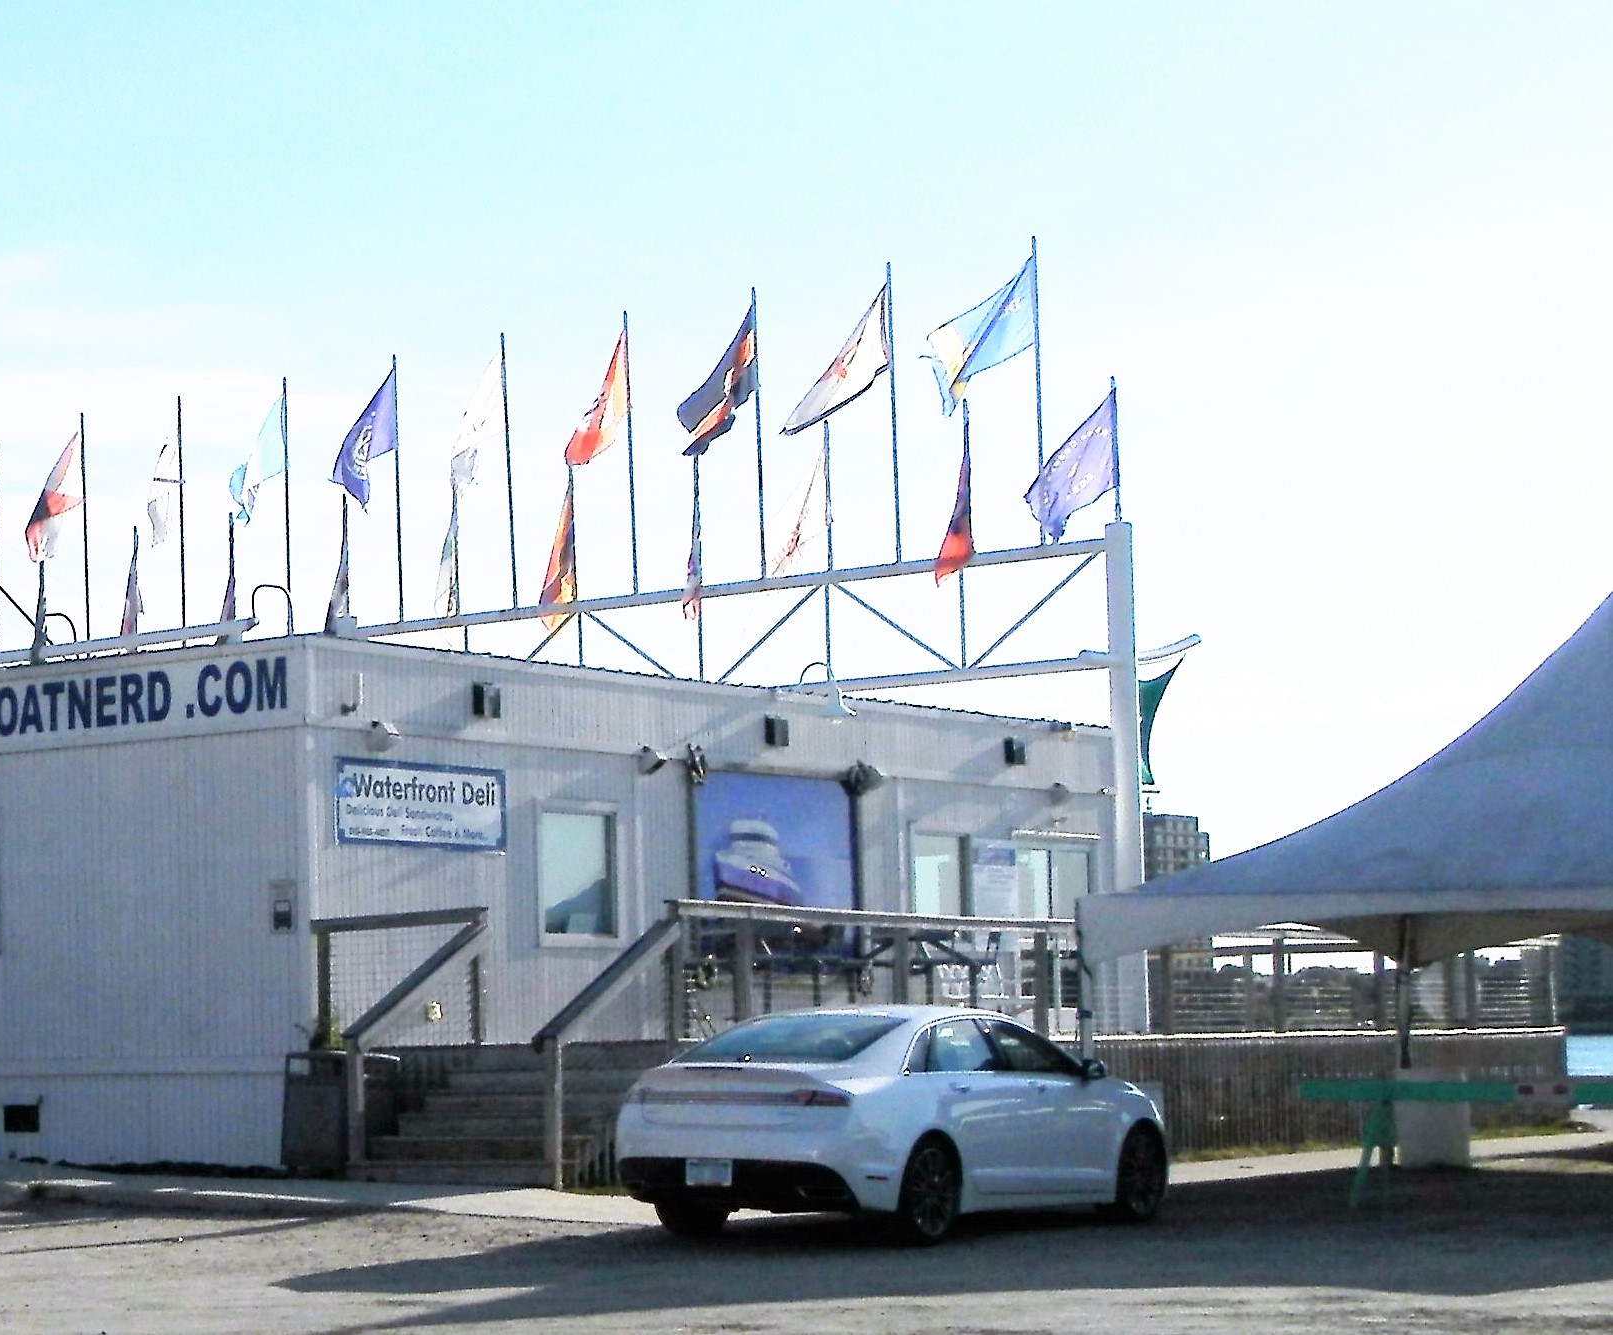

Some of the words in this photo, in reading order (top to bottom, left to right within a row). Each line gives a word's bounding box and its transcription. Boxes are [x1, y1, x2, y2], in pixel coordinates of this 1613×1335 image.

[185, 655, 287, 719] .COM
[353, 772, 456, 804] Waterfront
[462, 781, 496, 807] Deli
